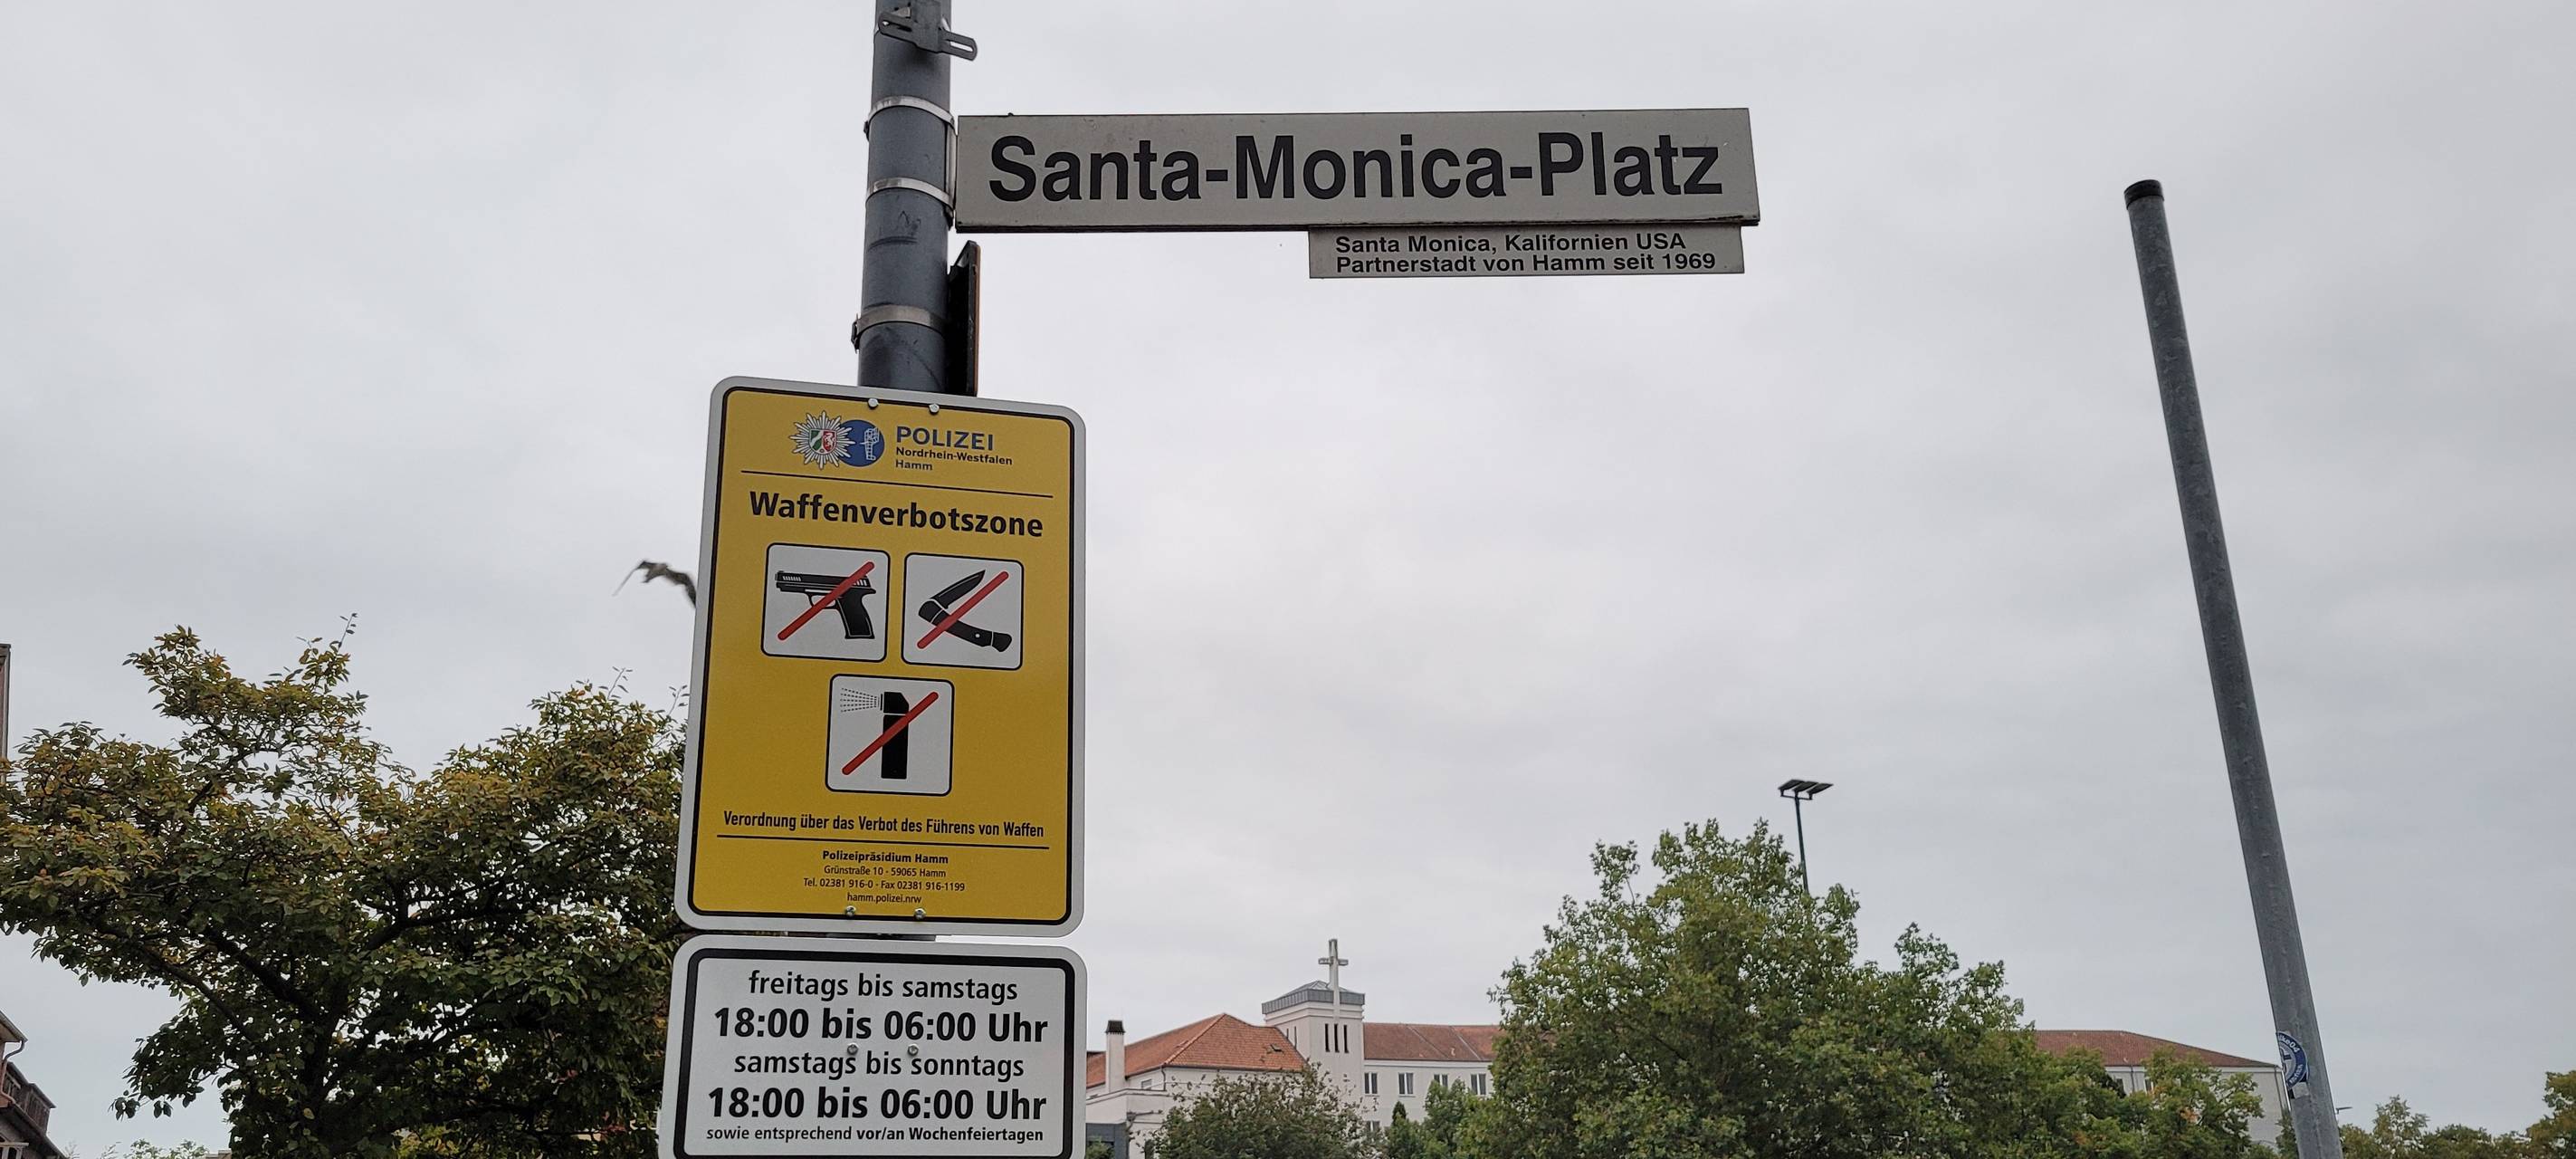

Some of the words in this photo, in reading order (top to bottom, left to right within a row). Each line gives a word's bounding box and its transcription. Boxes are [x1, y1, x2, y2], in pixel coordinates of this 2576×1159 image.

[988, 131, 1723, 202] Santa-Monica-Platz
[1335, 235, 1400, 254] Santa
[1407, 235, 1497, 255] Monica,
[1505, 233, 1628, 252] Kalifornien
[1636, 232, 1686, 250] USA
[1337, 254, 1476, 273] Partnerstadt
[1483, 258, 1524, 272] von
[1532, 254, 1606, 272] Hamm
[1613, 253, 1655, 271] seit
[1662, 253, 1716, 270] 1969
[895, 426, 994, 451] POLIZEI
[895, 446, 1013, 466] Nordrhein-Westfalen
[895, 459, 933, 471] Hamm
[749, 490, 1044, 538] Waffenverbotszone
[723, 810, 797, 832] Verordnung
[800, 813, 827, 829] über
[833, 815, 854, 830] das
[858, 815, 898, 832] Verbot
[901, 818, 922, 833] des
[926, 818, 976, 835] Führens
[978, 824, 1000, 836] von
[1003, 821, 1044, 838] Waffen
[822, 849, 911, 864] Polizeipräsidium
[914, 853, 949, 864] Hamm
[824, 865, 871, 876] Grünstraße
[873, 867, 884, 876] 10
[891, 867, 918, 877] 59065
[919, 867, 947, 878] Hamm
[803, 876, 818, 887] Tel.
[819, 877, 845, 888] 02381
[848, 878, 873, 889] 916-0
[881, 879, 896, 889] Fax
[896, 880, 922, 890] 02381
[925, 881, 966, 892] 916-1199
[846, 891, 922, 905] hamm.polizei.nrw
[748, 969, 849, 1001] freitags
[858, 972, 893, 997] bis
[902, 978, 1018, 1006] samstags
[714, 1007, 809, 1039] 18:00
[821, 1007, 872, 1039] bis
[883, 1011, 977, 1041] 06:00
[988, 1011, 1048, 1043] Uhr
[734, 1050, 858, 1081] samstags
[865, 1049, 902, 1075] bis
[911, 1055, 1025, 1083] sonntags
[708, 1087, 805, 1118] 18:00
[816, 1086, 868, 1119] bis
[880, 1088, 974, 1120] 06:00
[987, 1088, 1047, 1120] Uhr
[706, 1125, 749, 1140] sowie
[754, 1125, 853, 1144] entsprechend
[856, 1126, 905, 1140] vor/an
[909, 1125, 1044, 1145] Wochenfeiertagen
